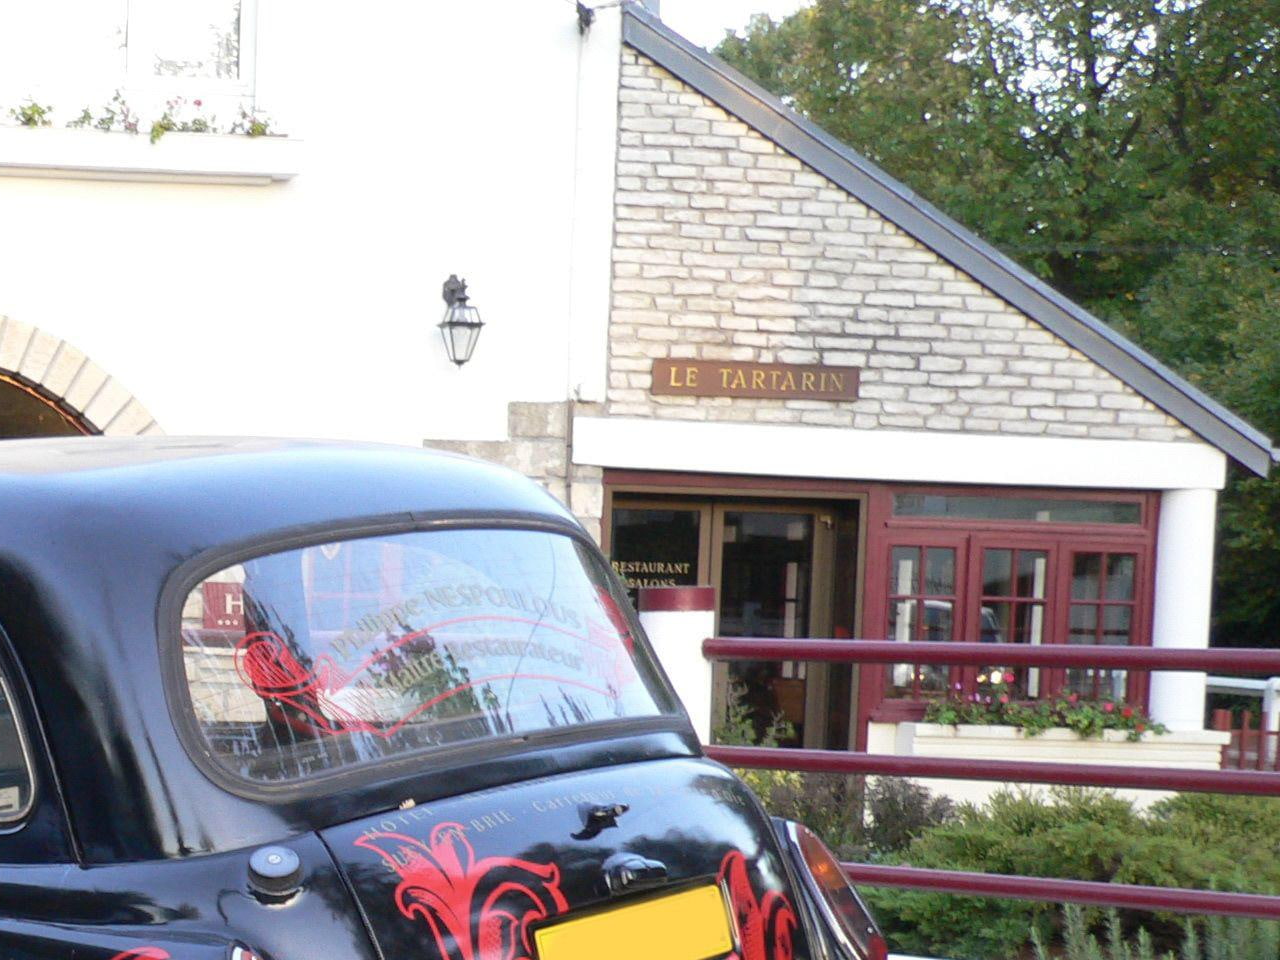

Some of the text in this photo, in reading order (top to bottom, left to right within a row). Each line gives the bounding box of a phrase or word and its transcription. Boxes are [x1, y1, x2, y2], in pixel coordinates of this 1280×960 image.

[670, 366, 845, 392] LE TARTARIN
[611, 560, 690, 575] RESTAURANT
